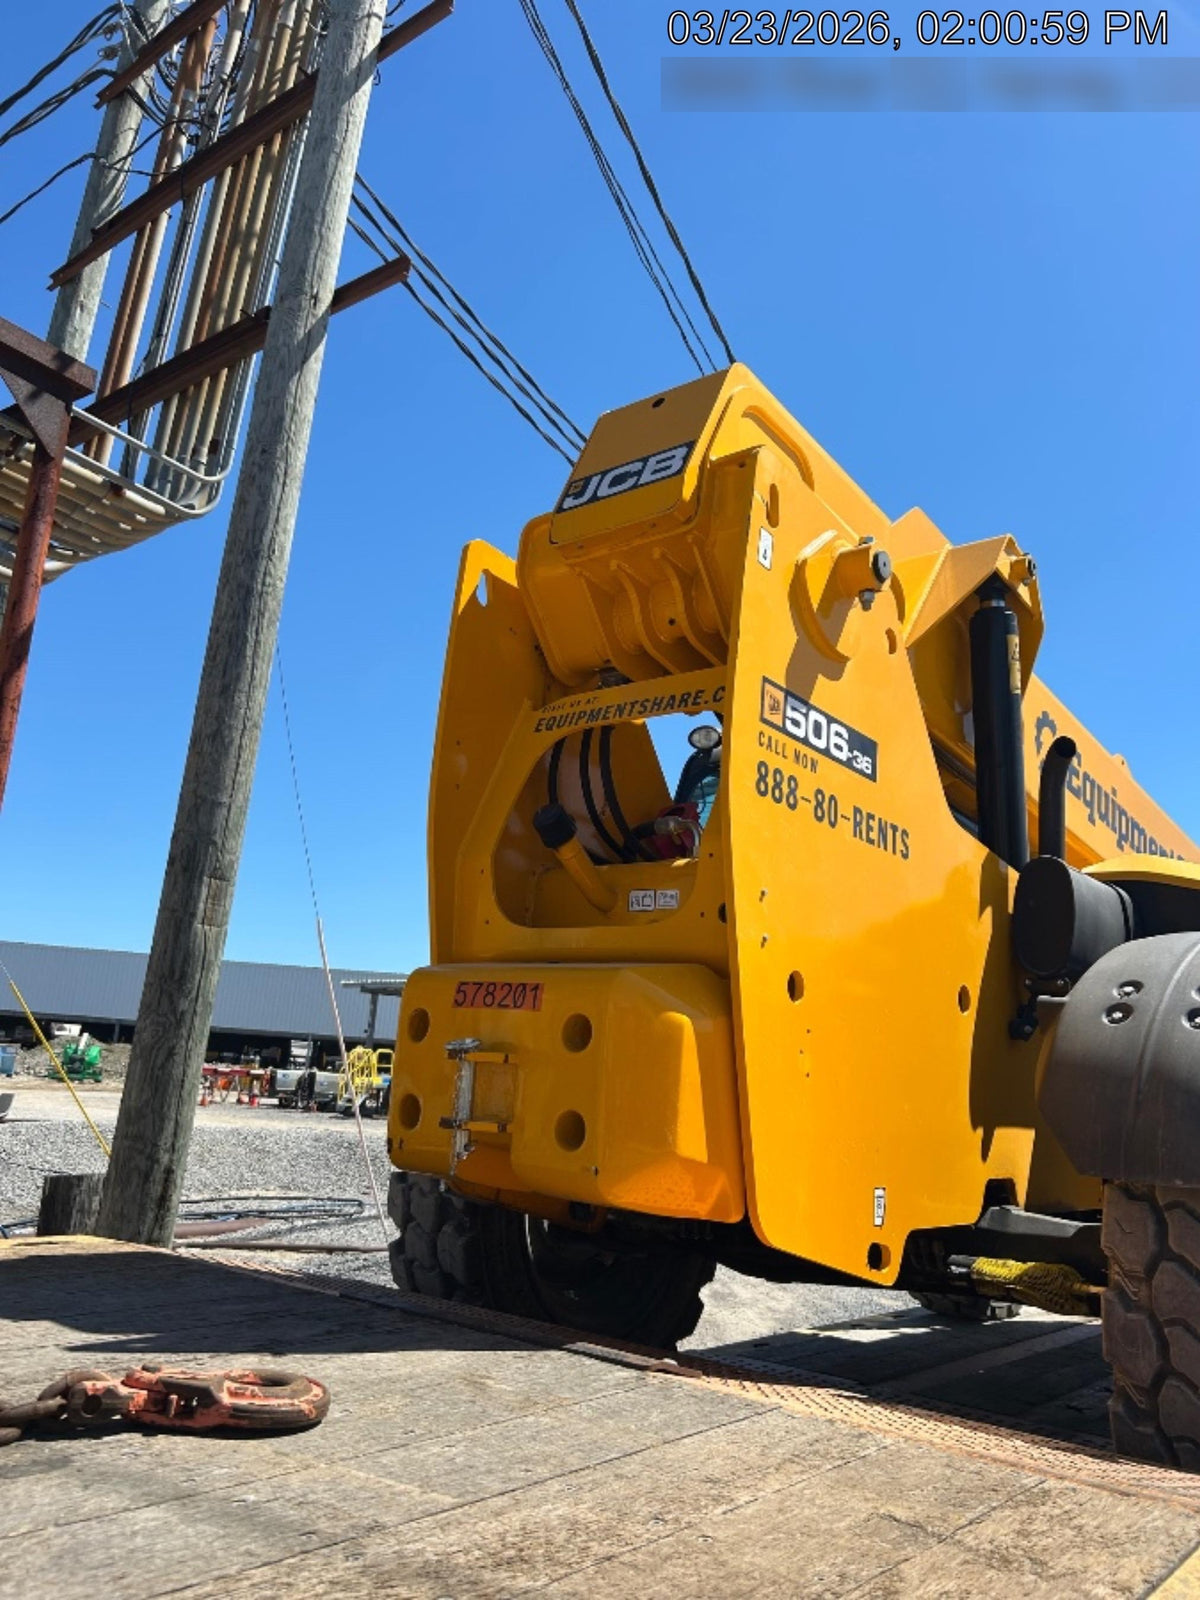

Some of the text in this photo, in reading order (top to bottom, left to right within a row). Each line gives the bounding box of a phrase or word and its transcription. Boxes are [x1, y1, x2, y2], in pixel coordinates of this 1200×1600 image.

[562, 444, 689, 510] JCB
[533, 685, 726, 733] EQUIPMENTSHARE.C
[758, 731, 819, 774] CALL NOW
[755, 760, 910, 860] 888-80-RENTS
[454, 981, 540, 1010] 578201
